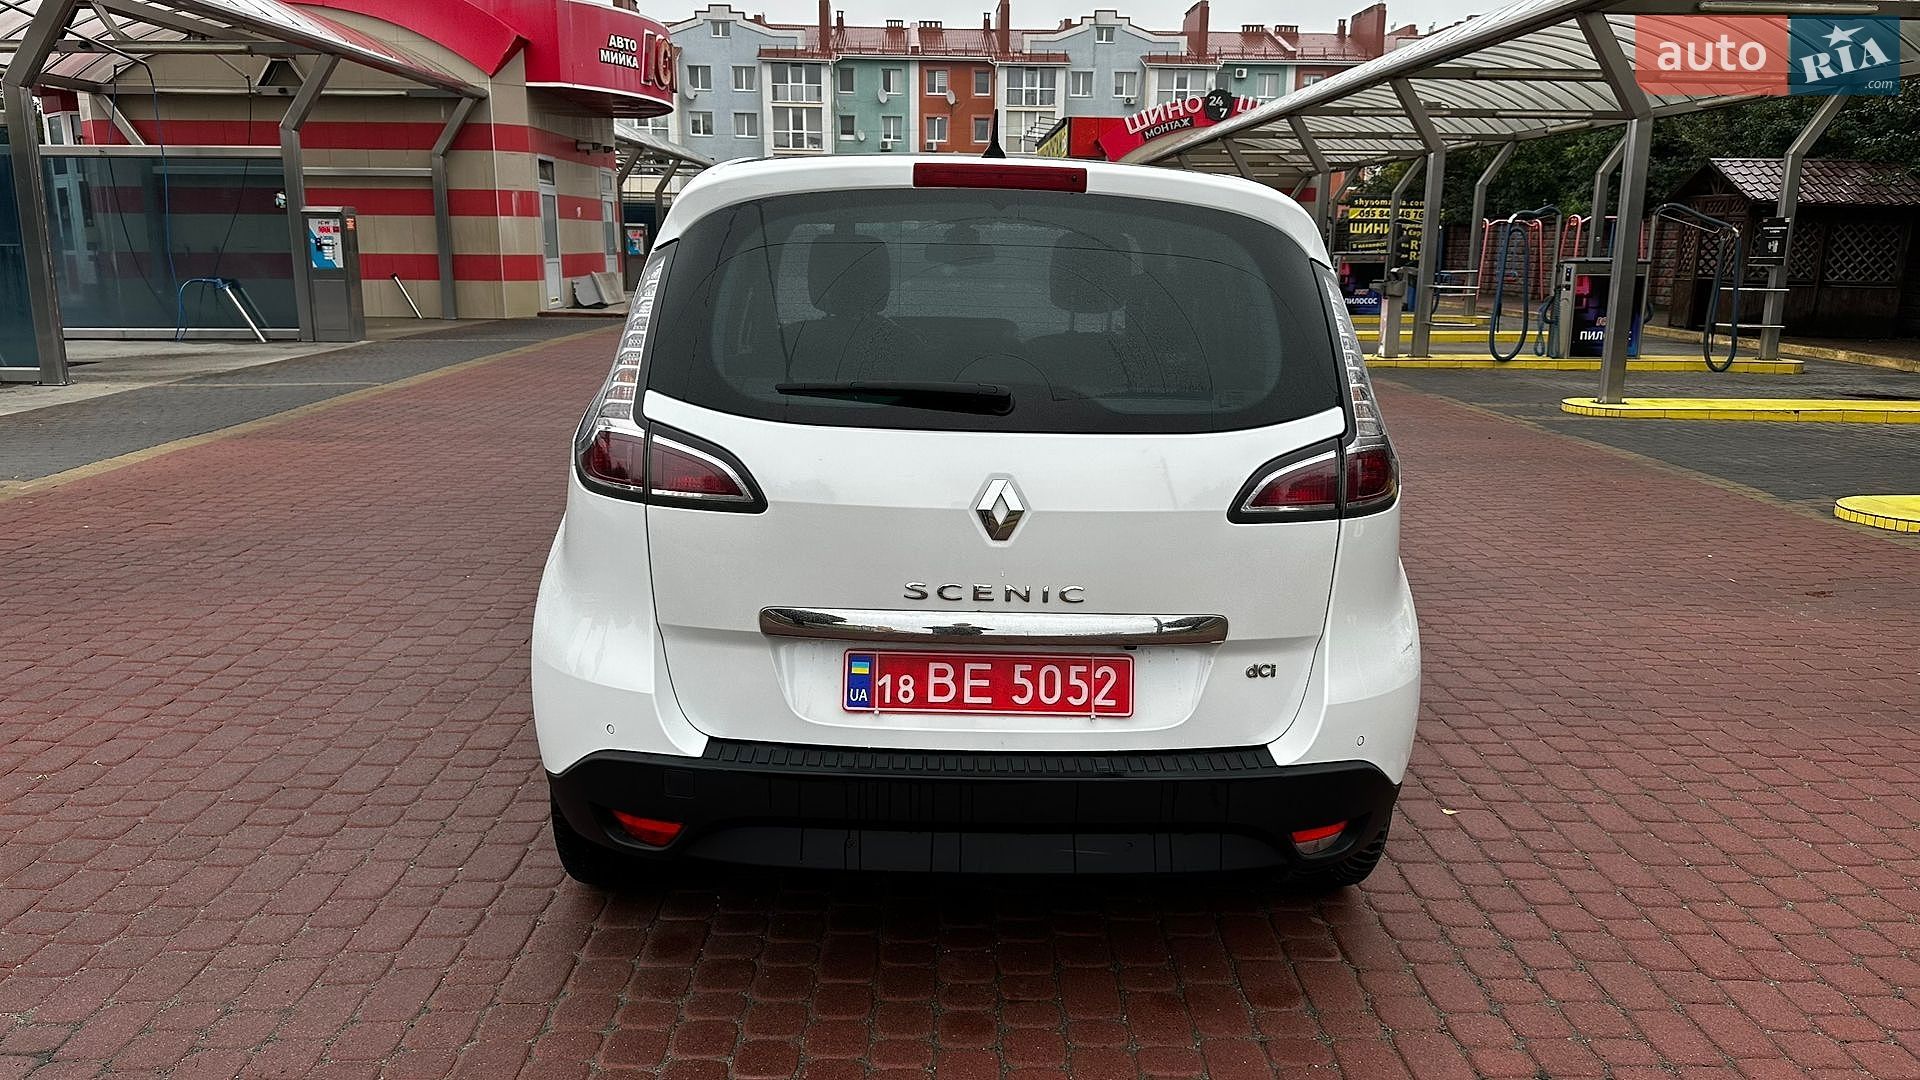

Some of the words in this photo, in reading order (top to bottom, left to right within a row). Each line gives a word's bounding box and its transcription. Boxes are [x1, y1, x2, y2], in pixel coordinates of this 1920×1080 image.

[608, 34, 637, 52] АВТО
[600, 49, 639, 69] МИЙКА
[1209, 96, 1224, 107] 24
[1124, 95, 1203, 134] ШИНО
[1145, 118, 1191, 140] МОНТАЖ
[903, 582, 1086, 603] SCENIC
[1245, 663, 1277, 679] dCi
[877, 674, 915, 704] 18
[927, 662, 993, 704] BE
[1011, 664, 1118, 707] 5052
[850, 688, 868, 702] UA
